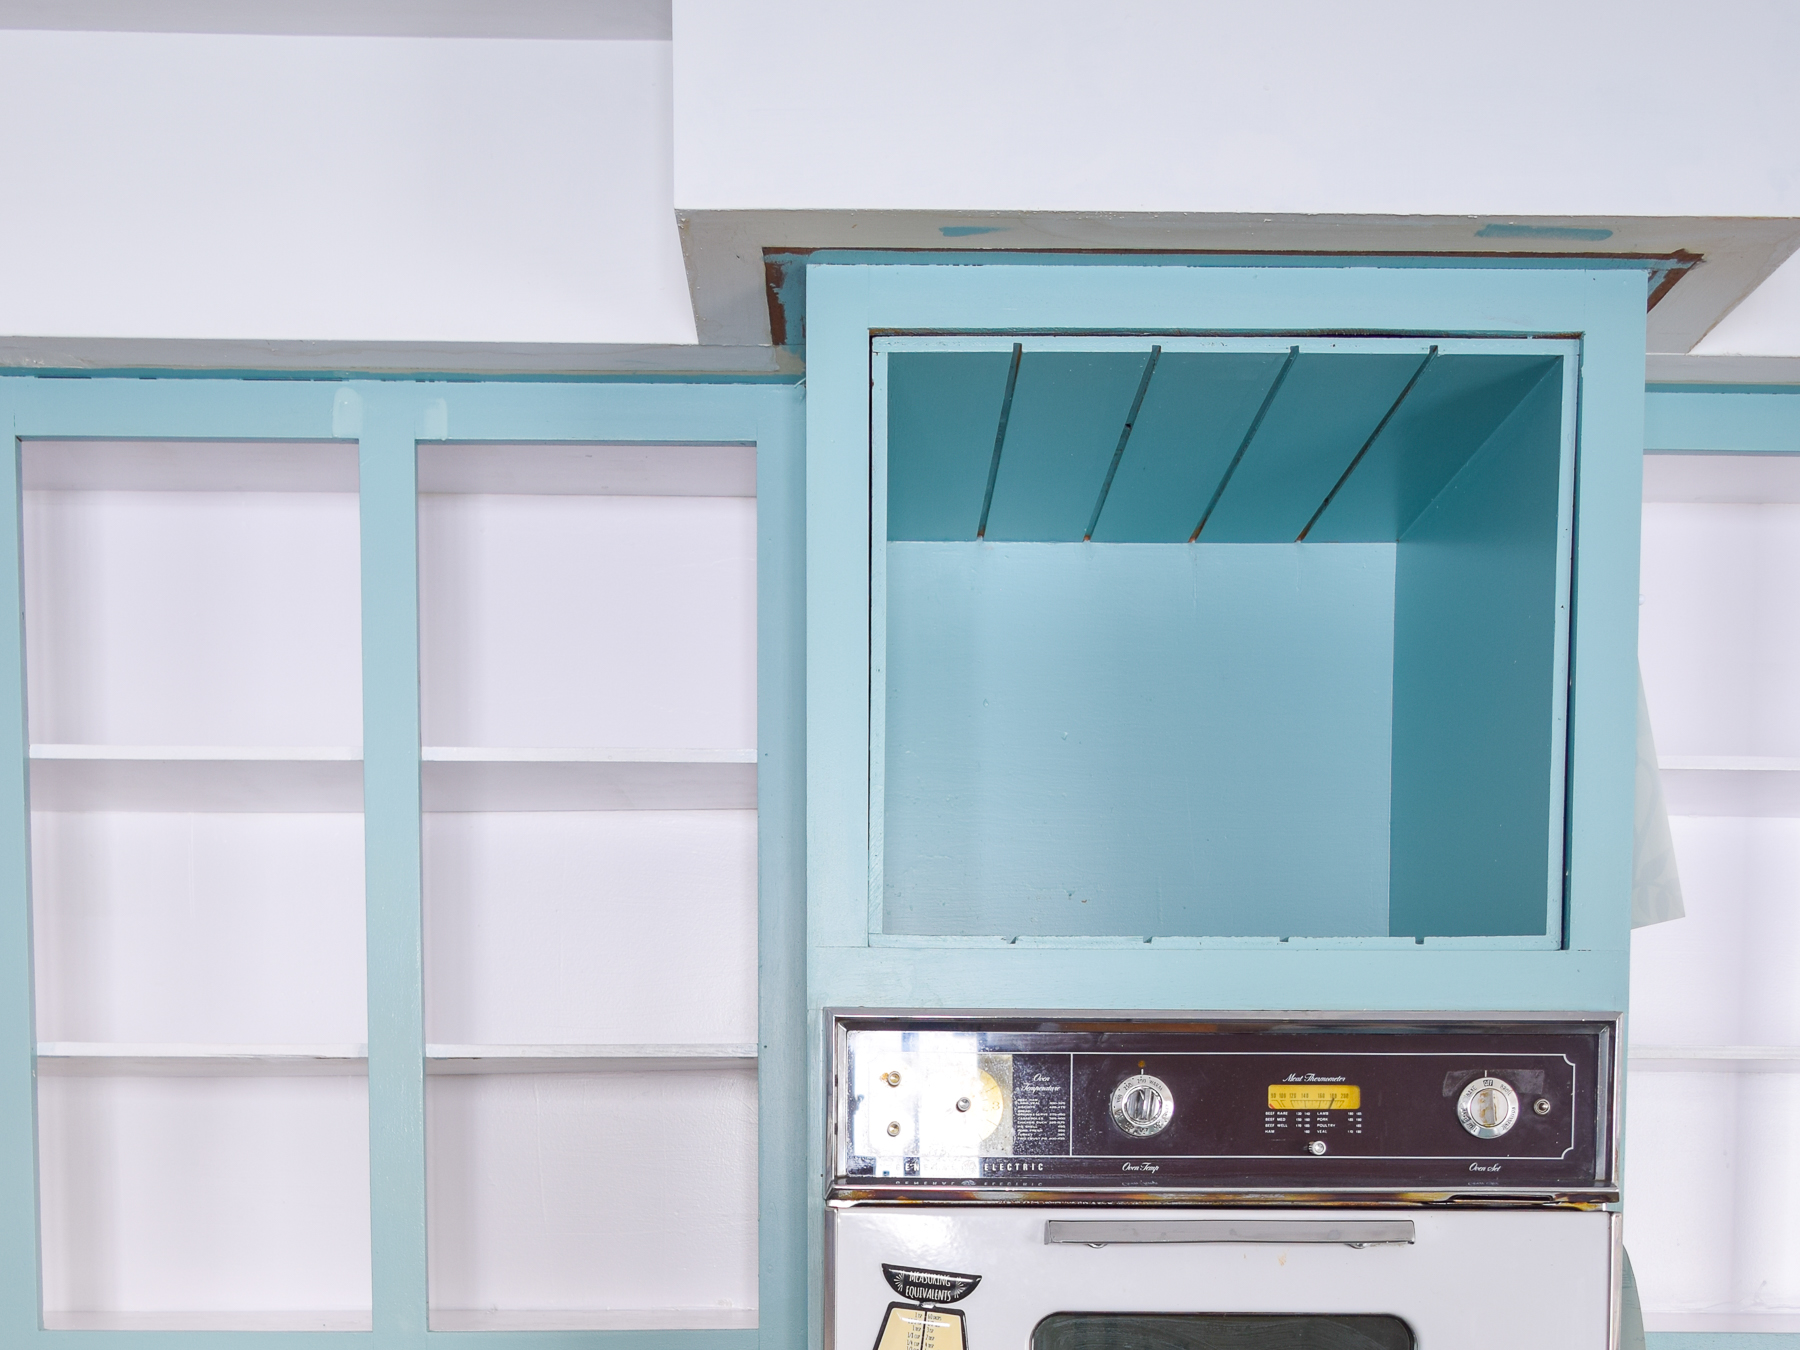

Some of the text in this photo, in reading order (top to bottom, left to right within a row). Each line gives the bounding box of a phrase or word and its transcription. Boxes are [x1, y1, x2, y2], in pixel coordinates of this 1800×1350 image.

[1034, 1073, 1050, 1081] Oven
[1282, 1073, 1346, 1082] Meat Thermometer
[1021, 1082, 1061, 1093] Temperature
[1122, 1162, 1159, 1174] Oven Temp
[1469, 1162, 1501, 1172] Oven Set
[909, 1271, 950, 1286] MEASURING
[906, 1286, 951, 1301] EQUIVALENTS
